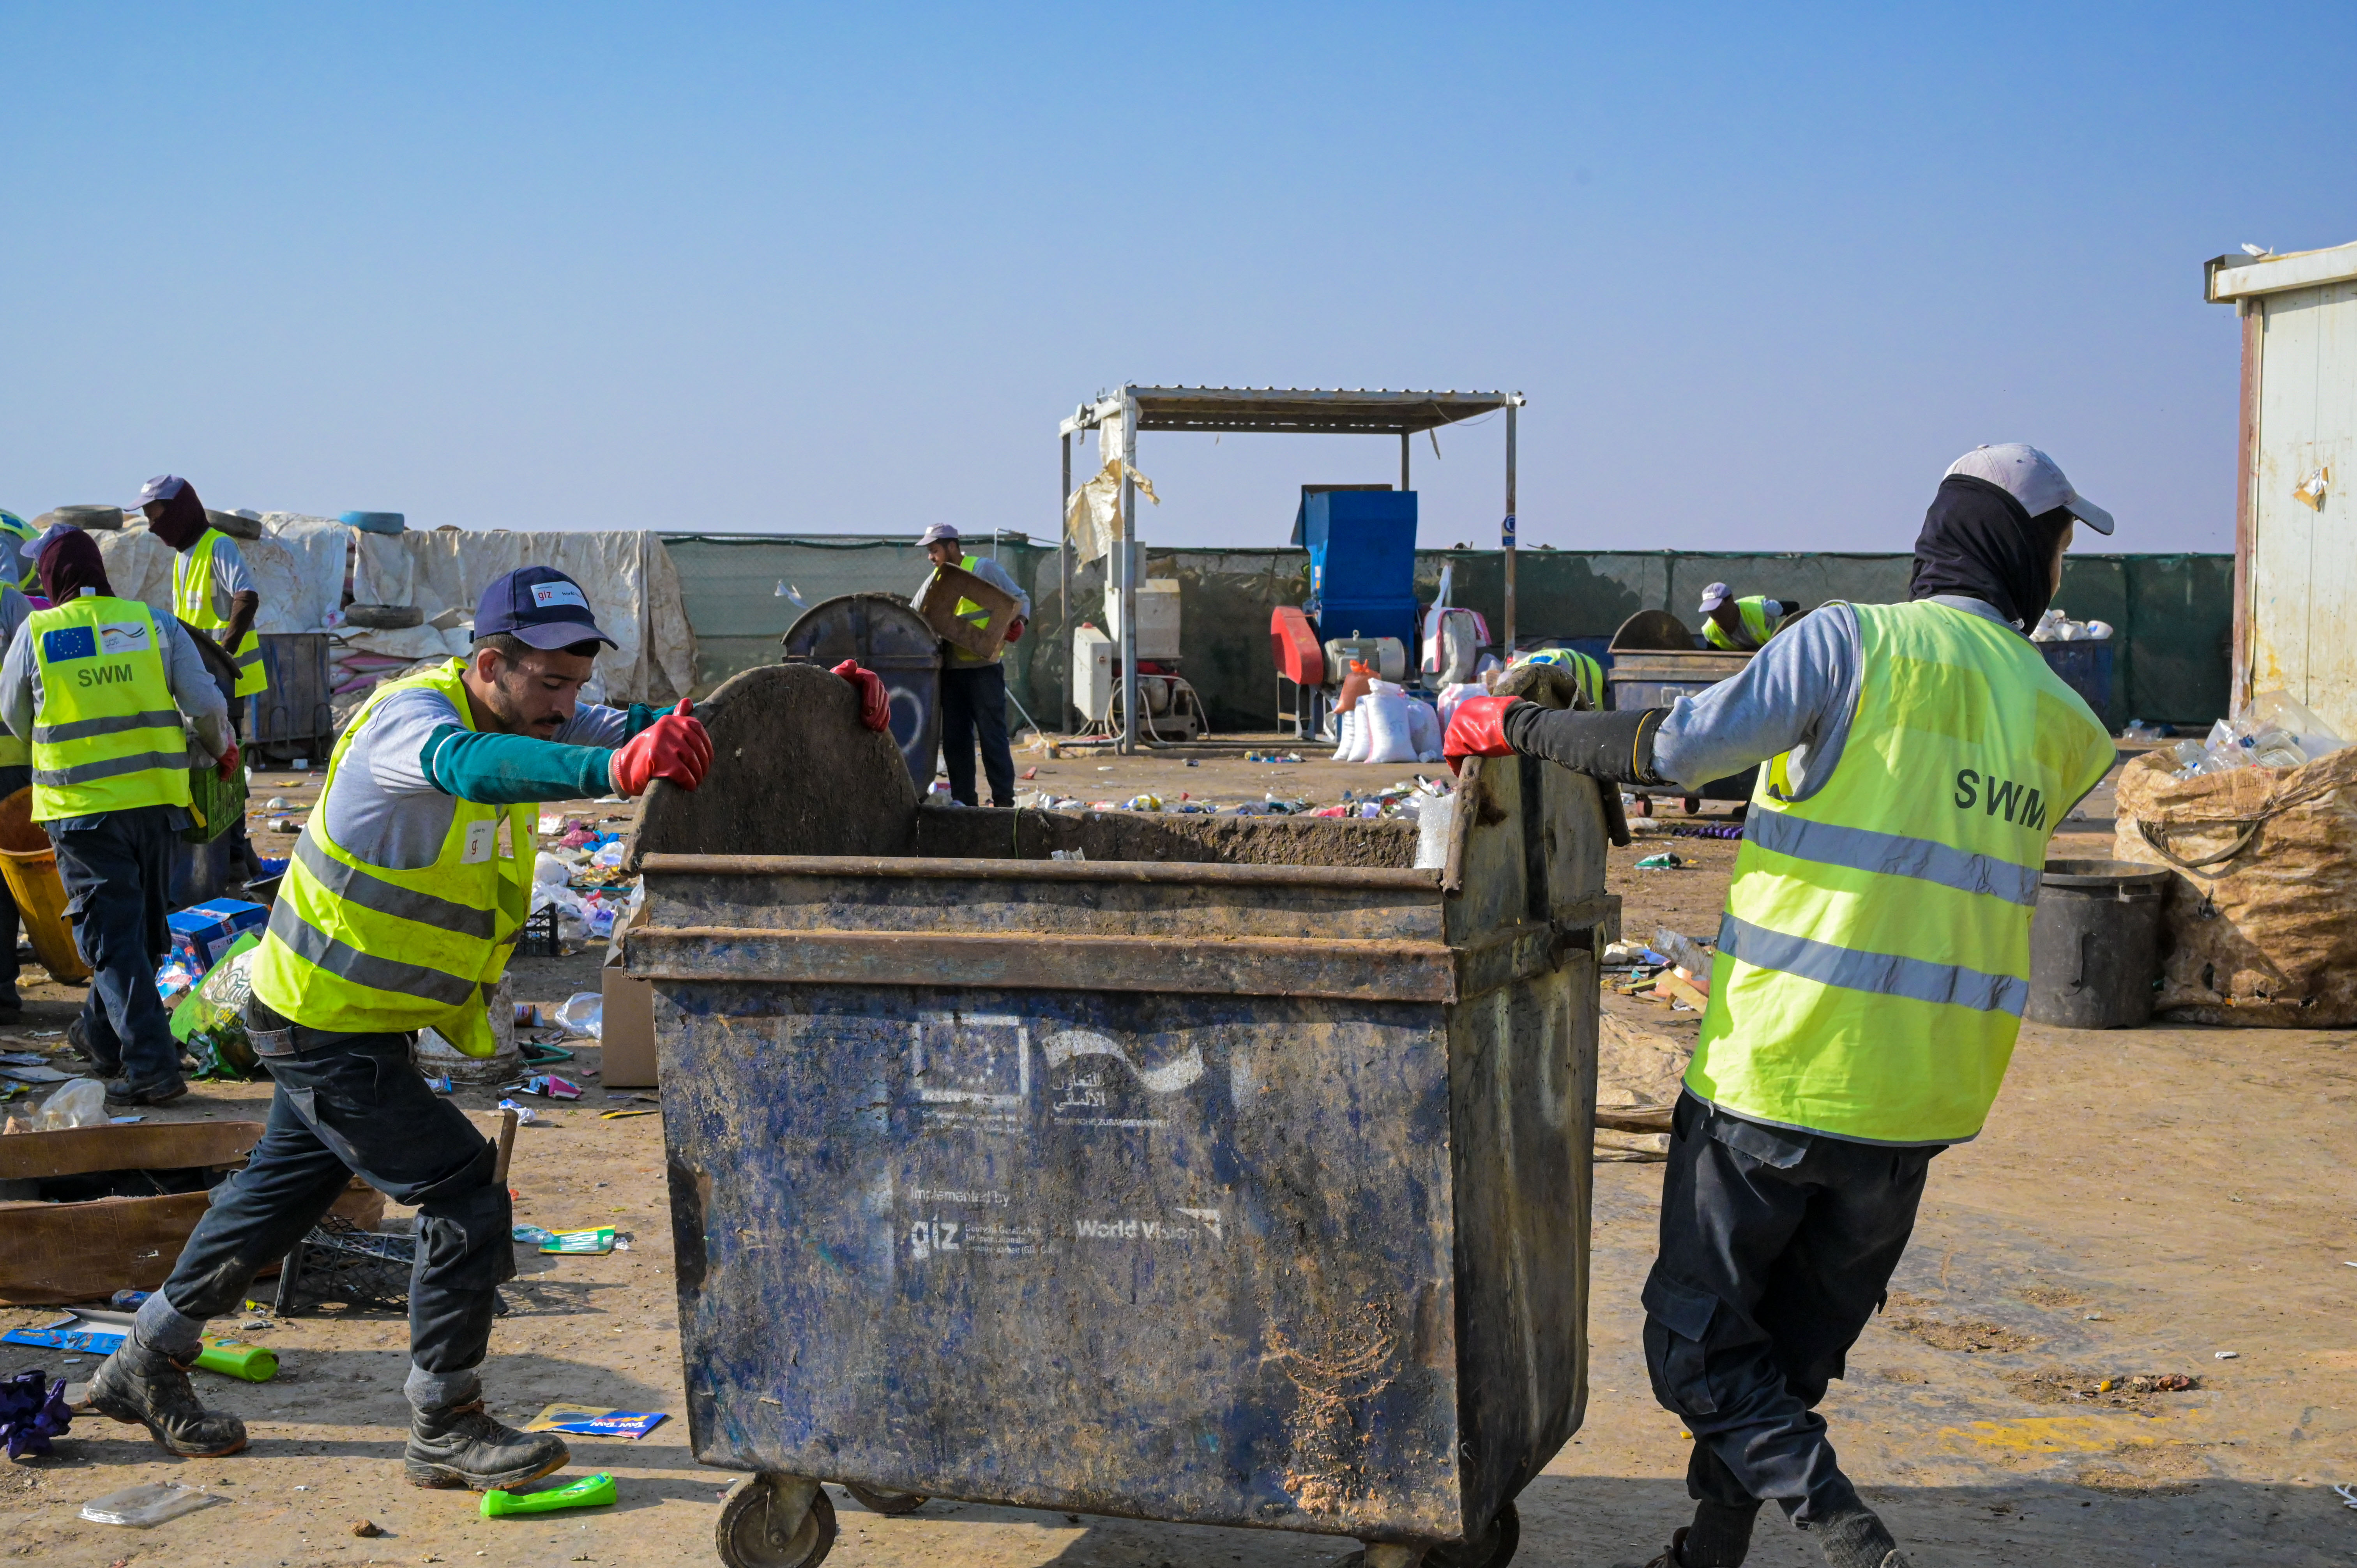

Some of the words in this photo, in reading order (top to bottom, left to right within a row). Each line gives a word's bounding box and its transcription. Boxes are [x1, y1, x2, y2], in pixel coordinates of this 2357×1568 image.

[538, 590, 552, 600] giz
[78, 664, 133, 687] SWM
[1954, 769, 2046, 831] SWM
[912, 1212, 959, 1259] giz
[1076, 1220, 1138, 1238] World
